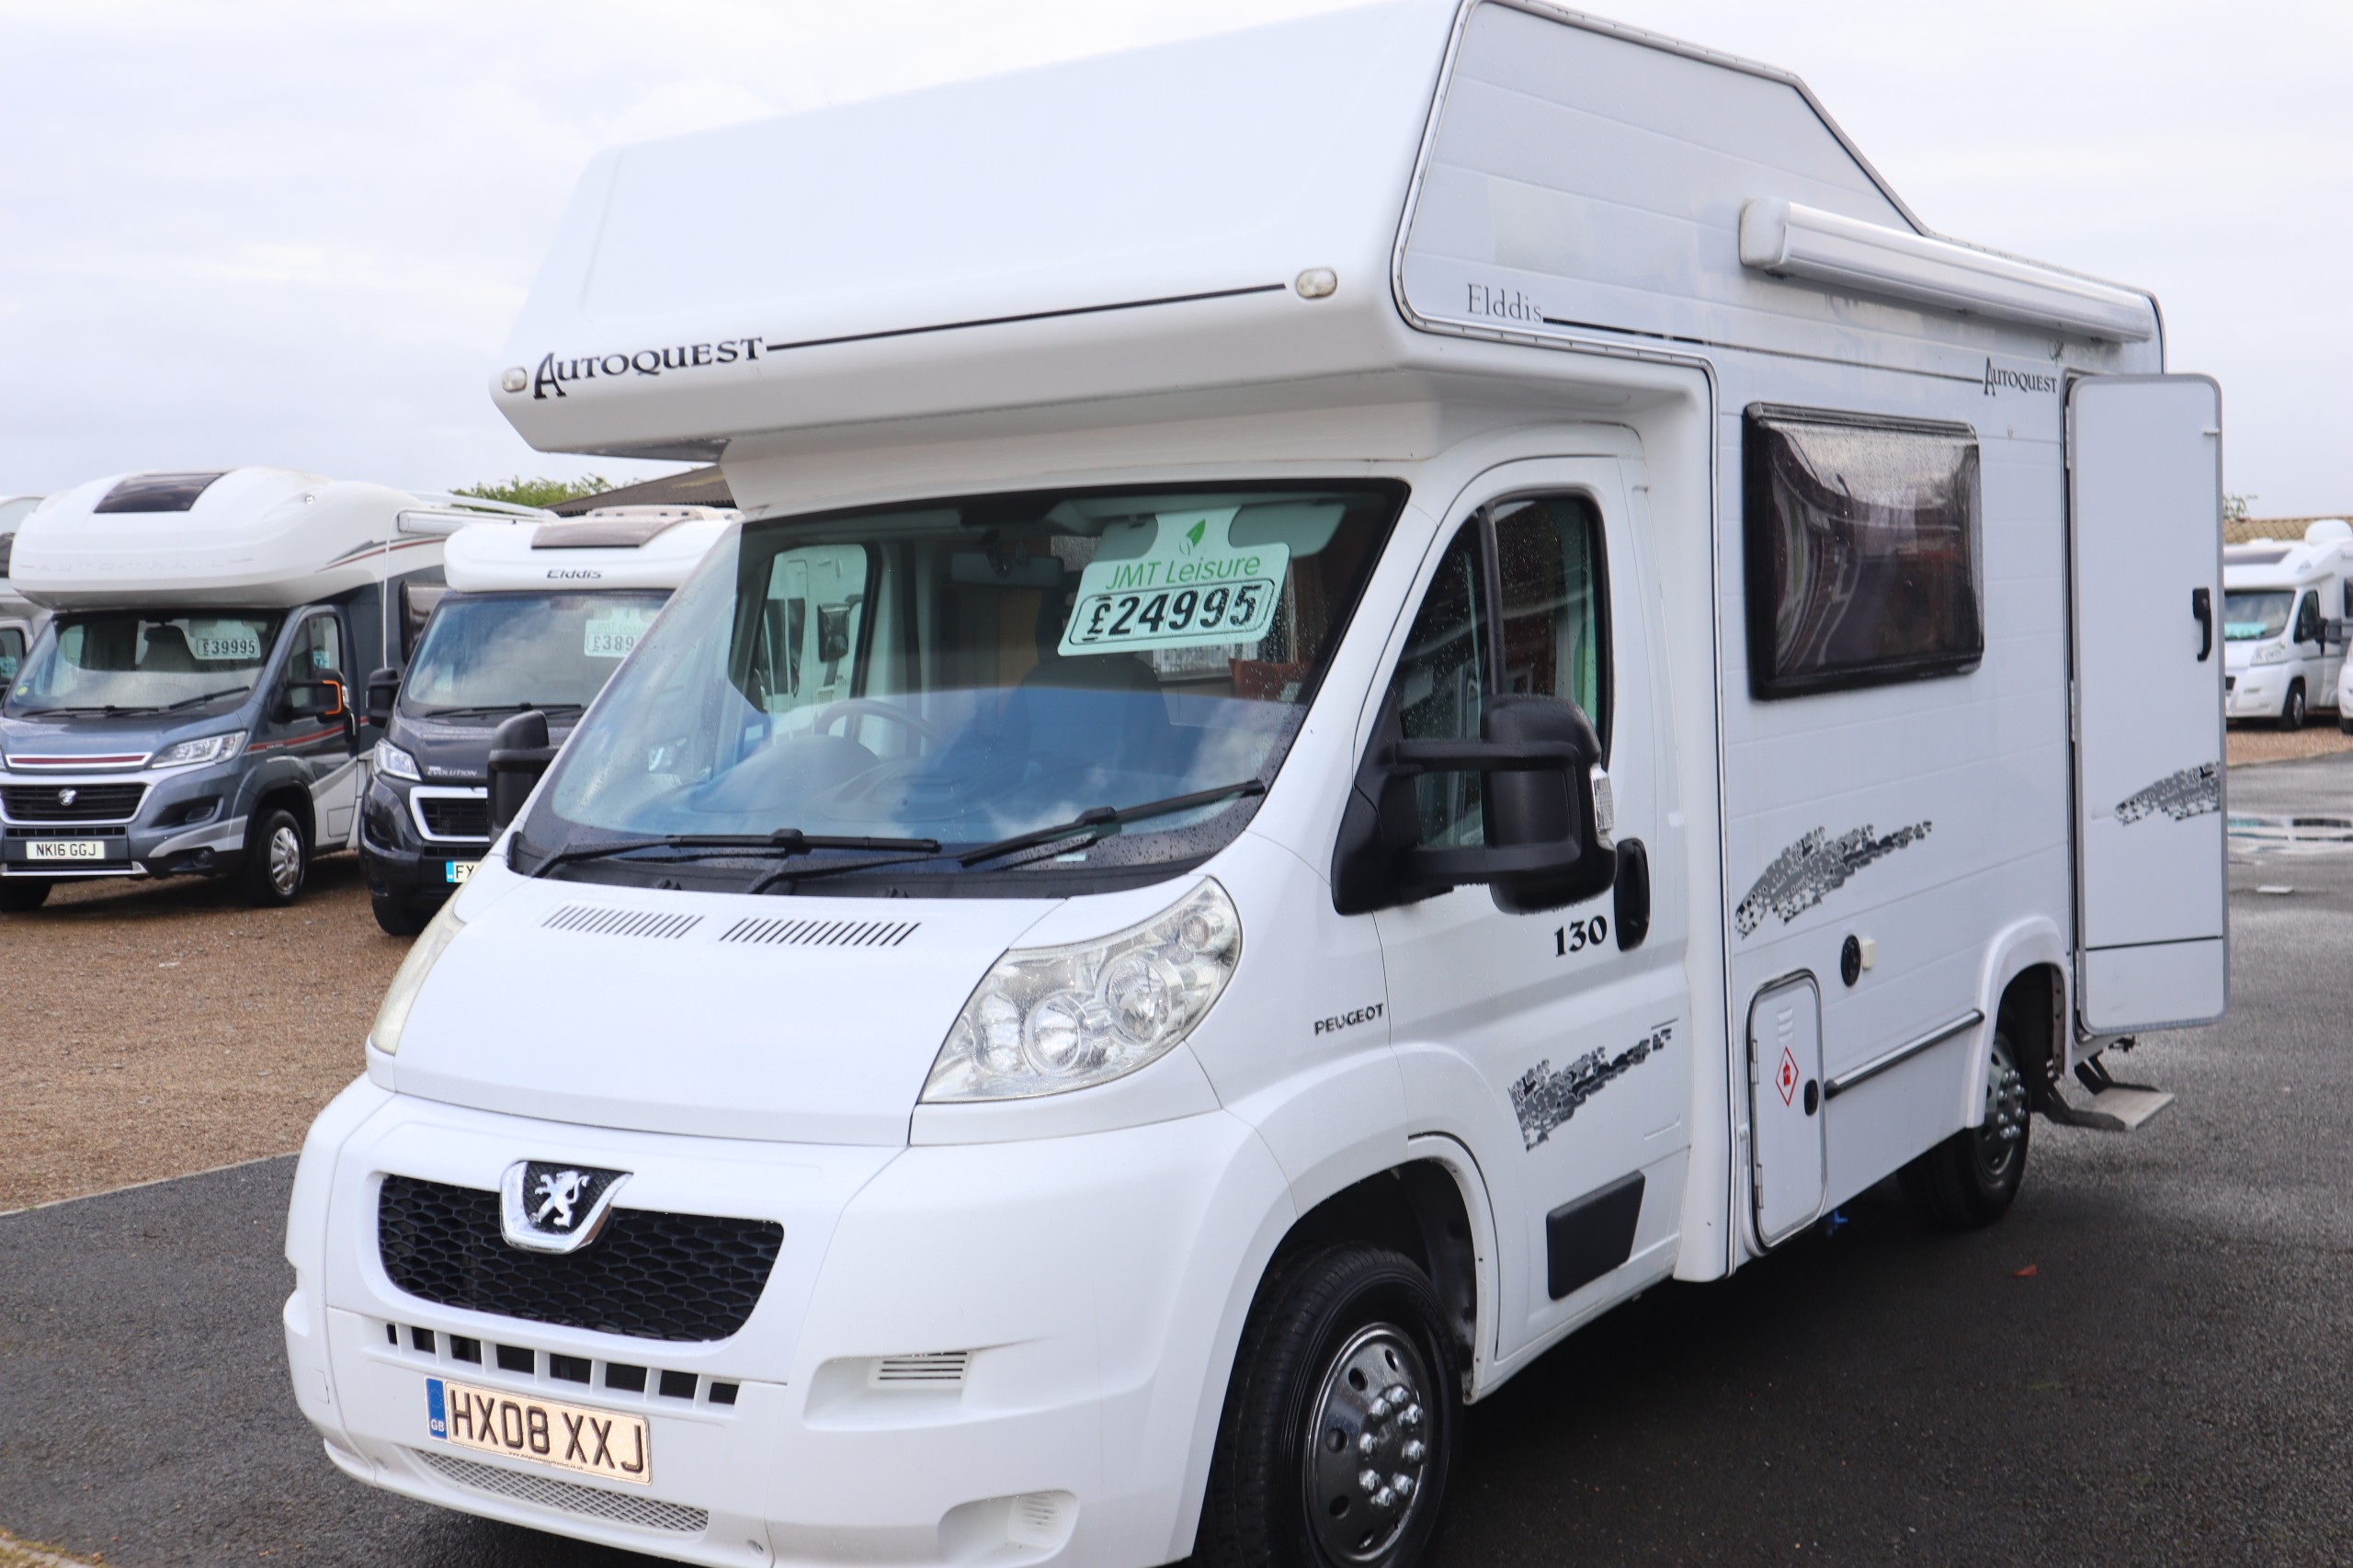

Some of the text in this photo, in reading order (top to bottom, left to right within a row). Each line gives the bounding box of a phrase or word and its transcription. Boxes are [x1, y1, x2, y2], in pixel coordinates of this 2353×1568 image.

[1467, 282, 1542, 324] Elddis
[533, 336, 763, 400] AUTOQUEST
[1984, 356, 2058, 397] AUTOQUEST
[547, 569, 602, 579] Elddis
[1106, 555, 1261, 591] JMT Leisure
[1085, 585, 1262, 638] £24995
[202, 639, 256, 655] £39995
[593, 635, 641, 652] £389
[37, 844, 96, 856] NK16 GGJ
[1554, 915, 1608, 958] 130
[1314, 1003, 1384, 1036] PEUGEOT
[430, 1418, 445, 1433] GB
[449, 1389, 644, 1473] HX08 XXJ
